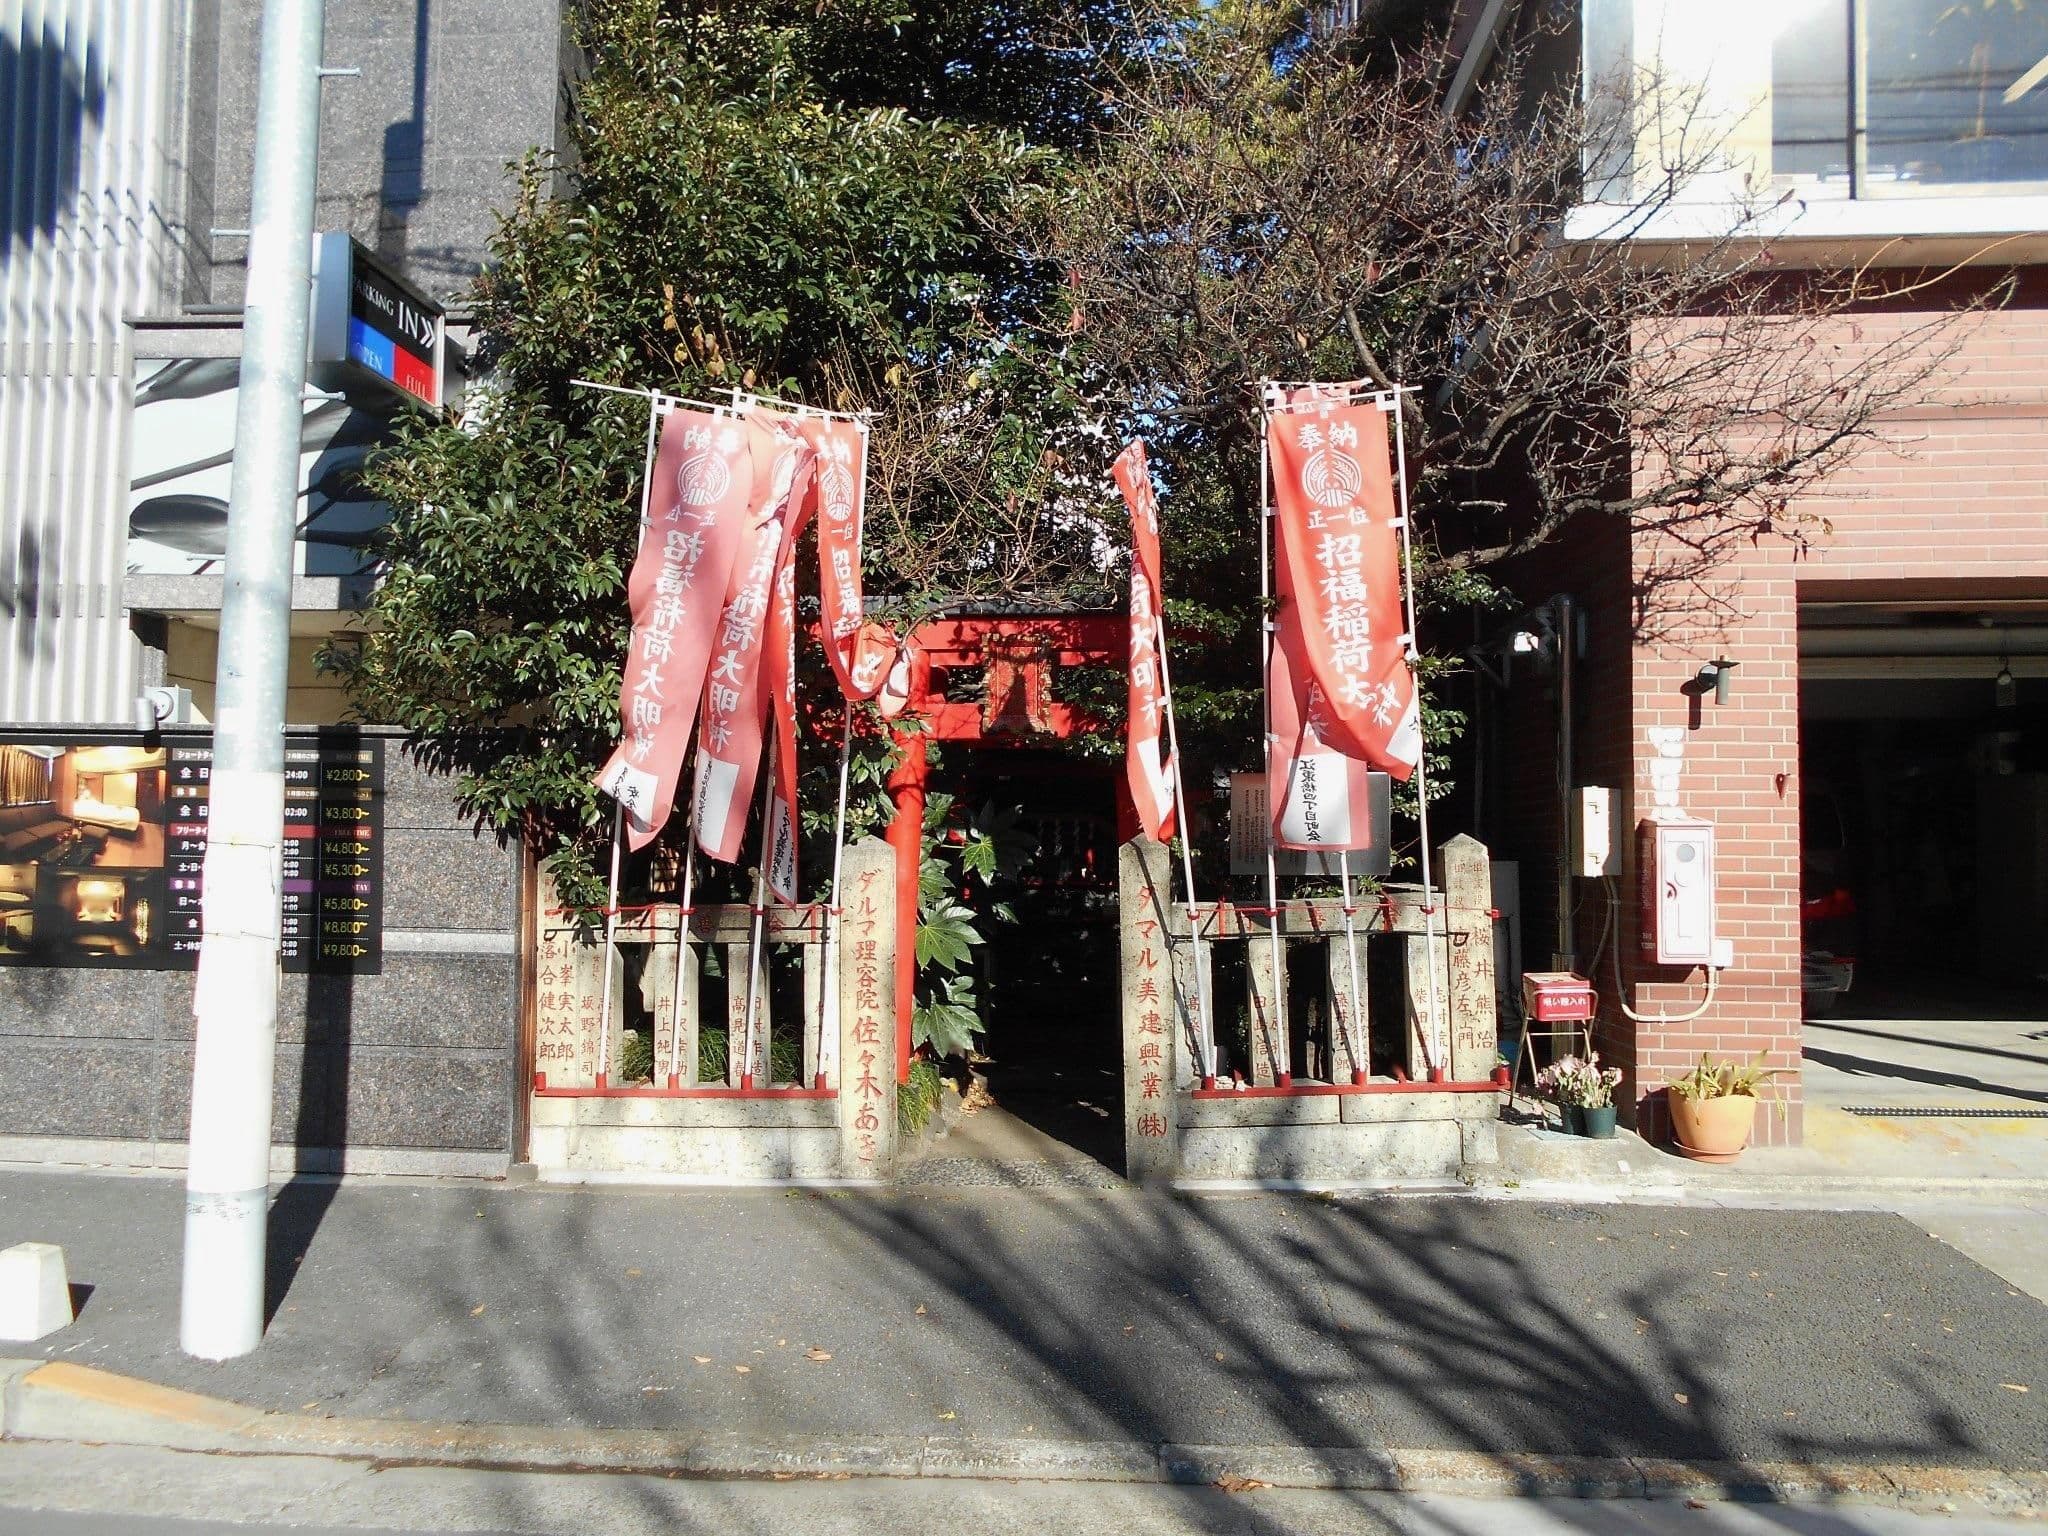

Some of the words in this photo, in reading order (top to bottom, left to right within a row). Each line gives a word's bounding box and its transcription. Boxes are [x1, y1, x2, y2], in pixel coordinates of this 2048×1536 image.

[355, 279, 394, 316] ARKING
[398, 300, 420, 340] IN
[1297, 421, 1358, 452] 奉納
[1307, 505, 1370, 529] 正一位
